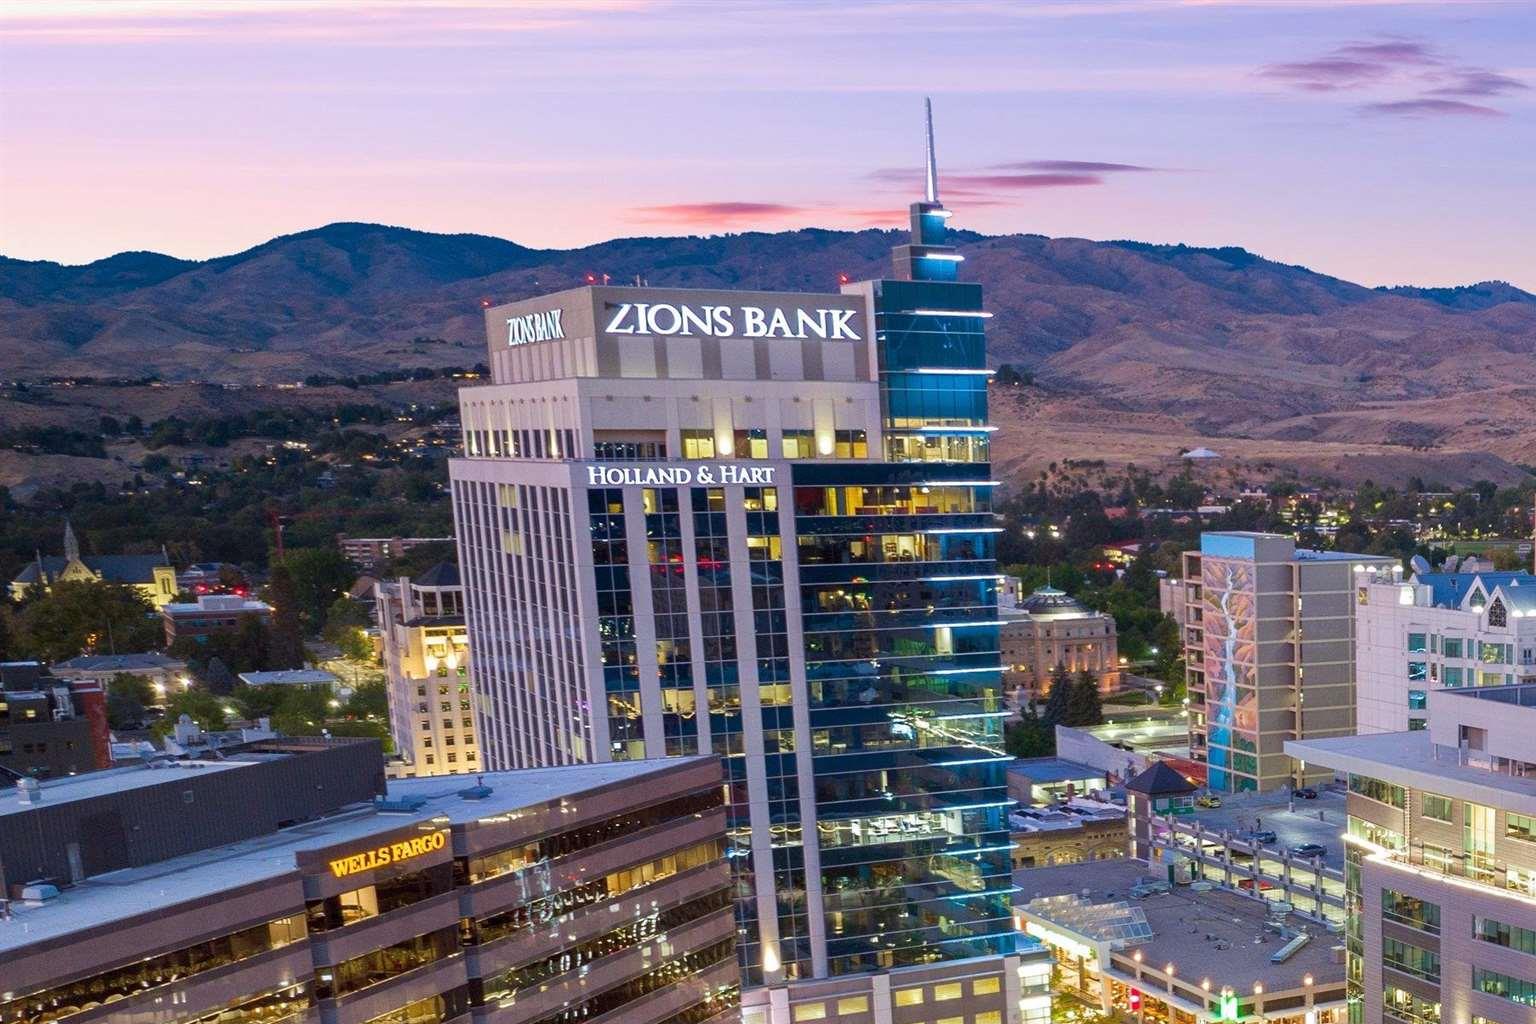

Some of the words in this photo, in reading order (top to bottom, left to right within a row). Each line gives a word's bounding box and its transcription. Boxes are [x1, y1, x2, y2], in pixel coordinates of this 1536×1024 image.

[506, 313, 536, 346] ZIONS
[533, 309, 566, 342] BANK
[604, 303, 734, 337] ZIONS
[740, 306, 861, 340] BANK
[587, 466, 692, 485] HOLLAND
[697, 466, 716, 484] &
[720, 465, 774, 484] HART
[329, 847, 391, 877] WELLS
[390, 832, 445, 861] FARGO
